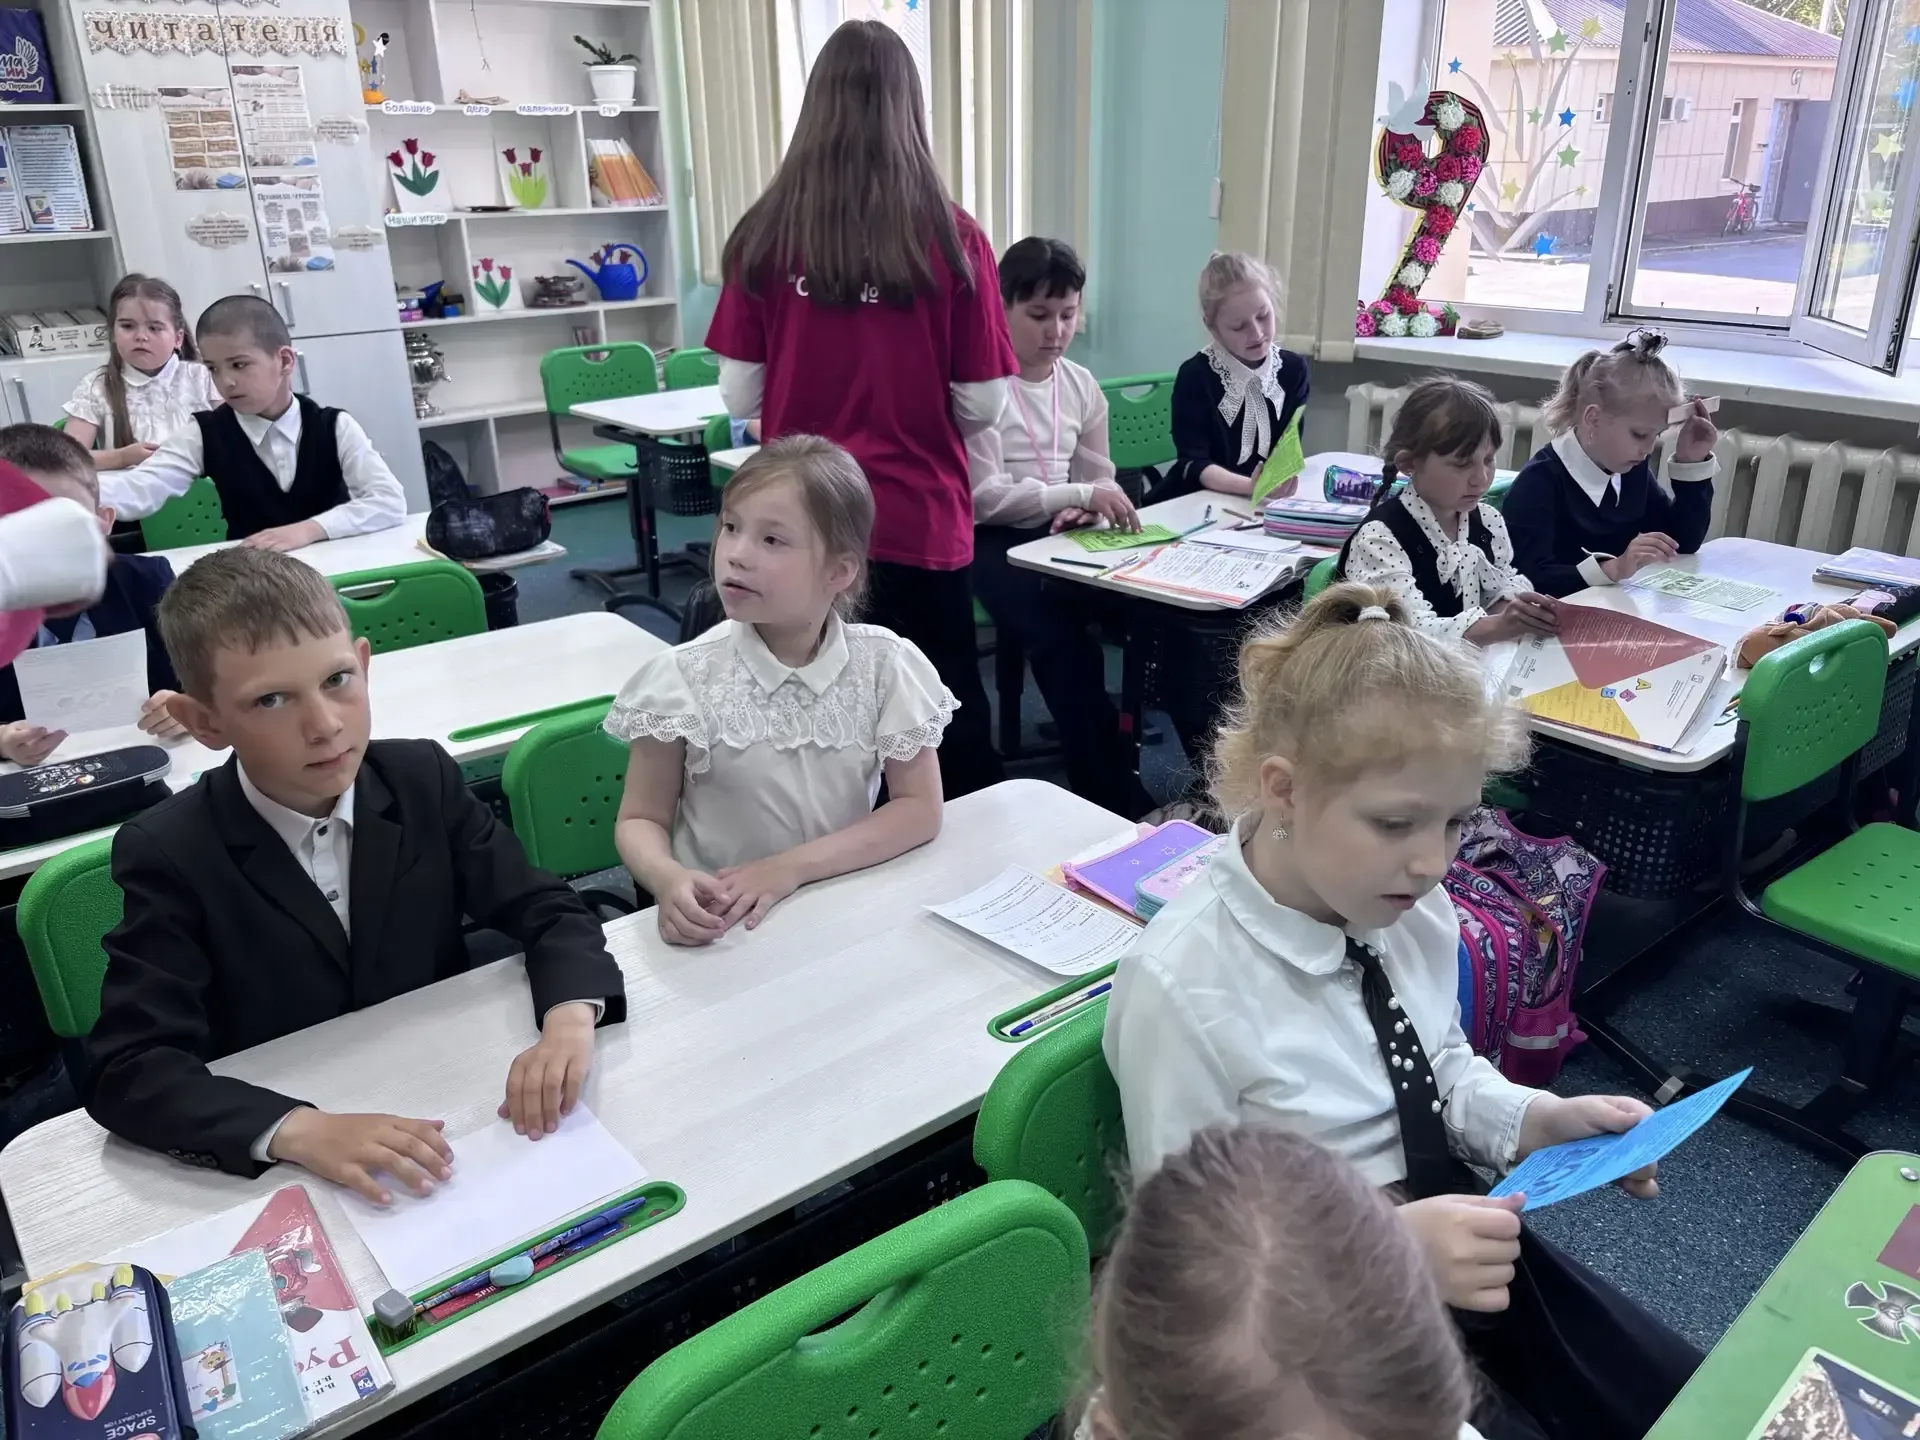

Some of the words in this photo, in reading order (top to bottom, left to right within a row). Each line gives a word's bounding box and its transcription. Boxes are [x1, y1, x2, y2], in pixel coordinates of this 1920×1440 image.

[385, 103, 433, 113] Большие
[474, 1285, 498, 1298] SPID
[294, 1335, 361, 1375] Рус
[103, 1408, 153, 1428] EXPLORATION
[105, 1415, 157, 1440] SPACE
